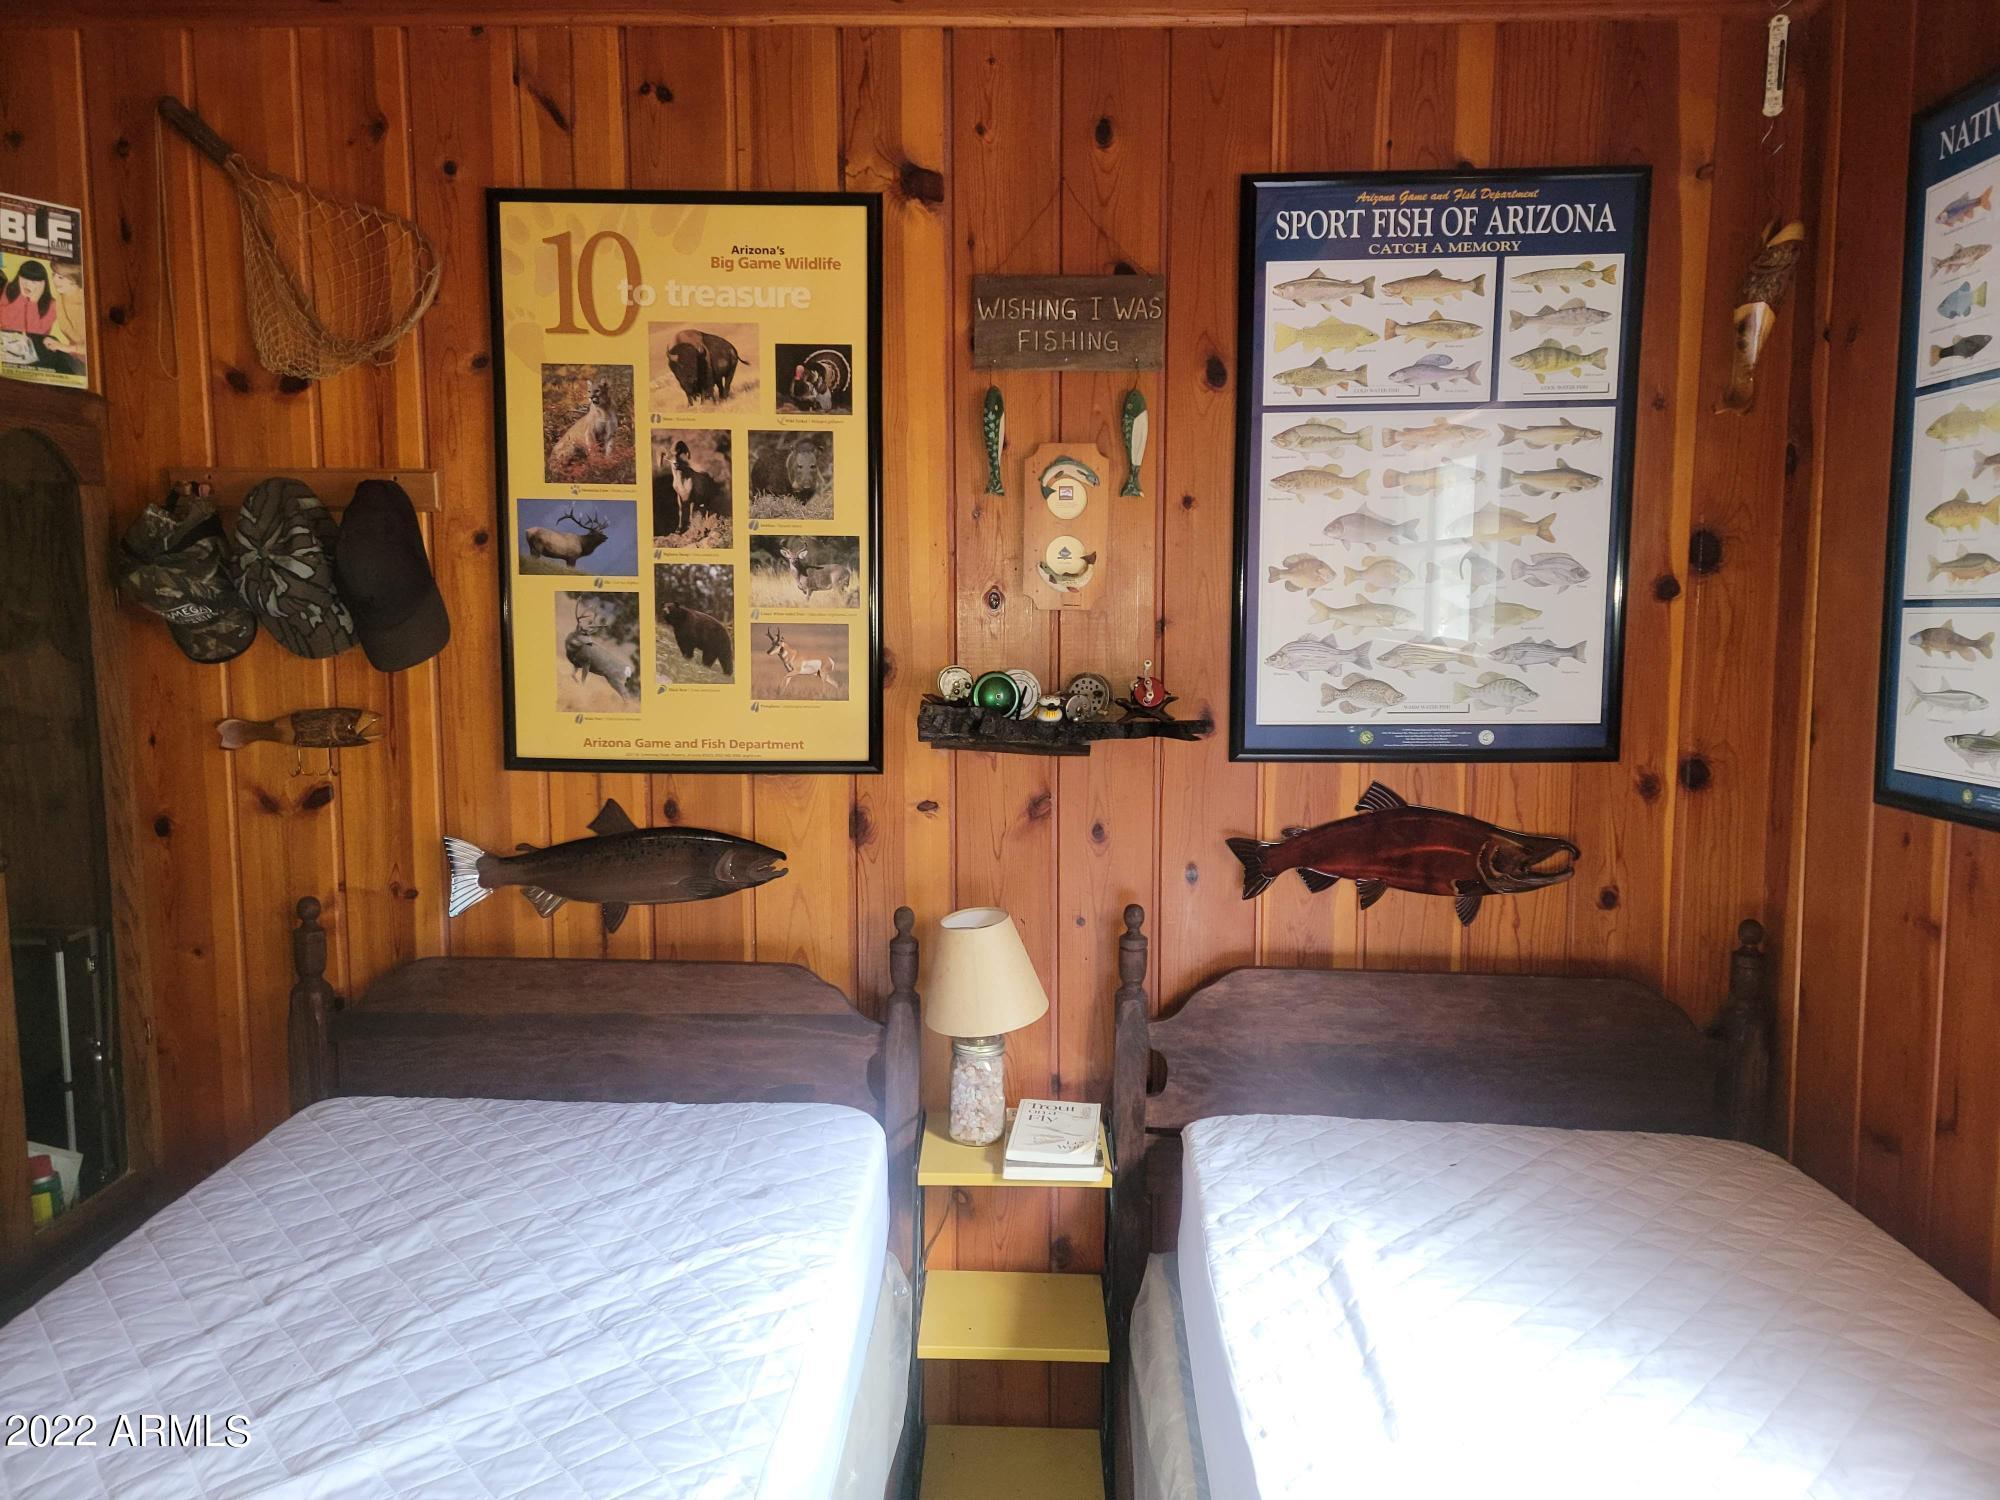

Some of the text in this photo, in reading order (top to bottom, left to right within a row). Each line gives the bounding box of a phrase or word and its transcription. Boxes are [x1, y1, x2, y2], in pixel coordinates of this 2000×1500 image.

[1355, 187, 1539, 206] Arizona Game and Fish Department
[1275, 202, 1617, 240] SPORT FISH OF ARIZONA
[731, 245, 785, 256] Arizona's
[1368, 241, 1522, 254] CATCH A MEMORY
[710, 256, 842, 272] Big Game Wildlife
[542, 230, 642, 337] 10
[617, 278, 812, 310] to treasure
[977, 297, 1162, 321] WISHING I WAS
[1018, 330, 1119, 352] FISHING
[583, 738, 804, 752] Arizona Game and Fish Department
